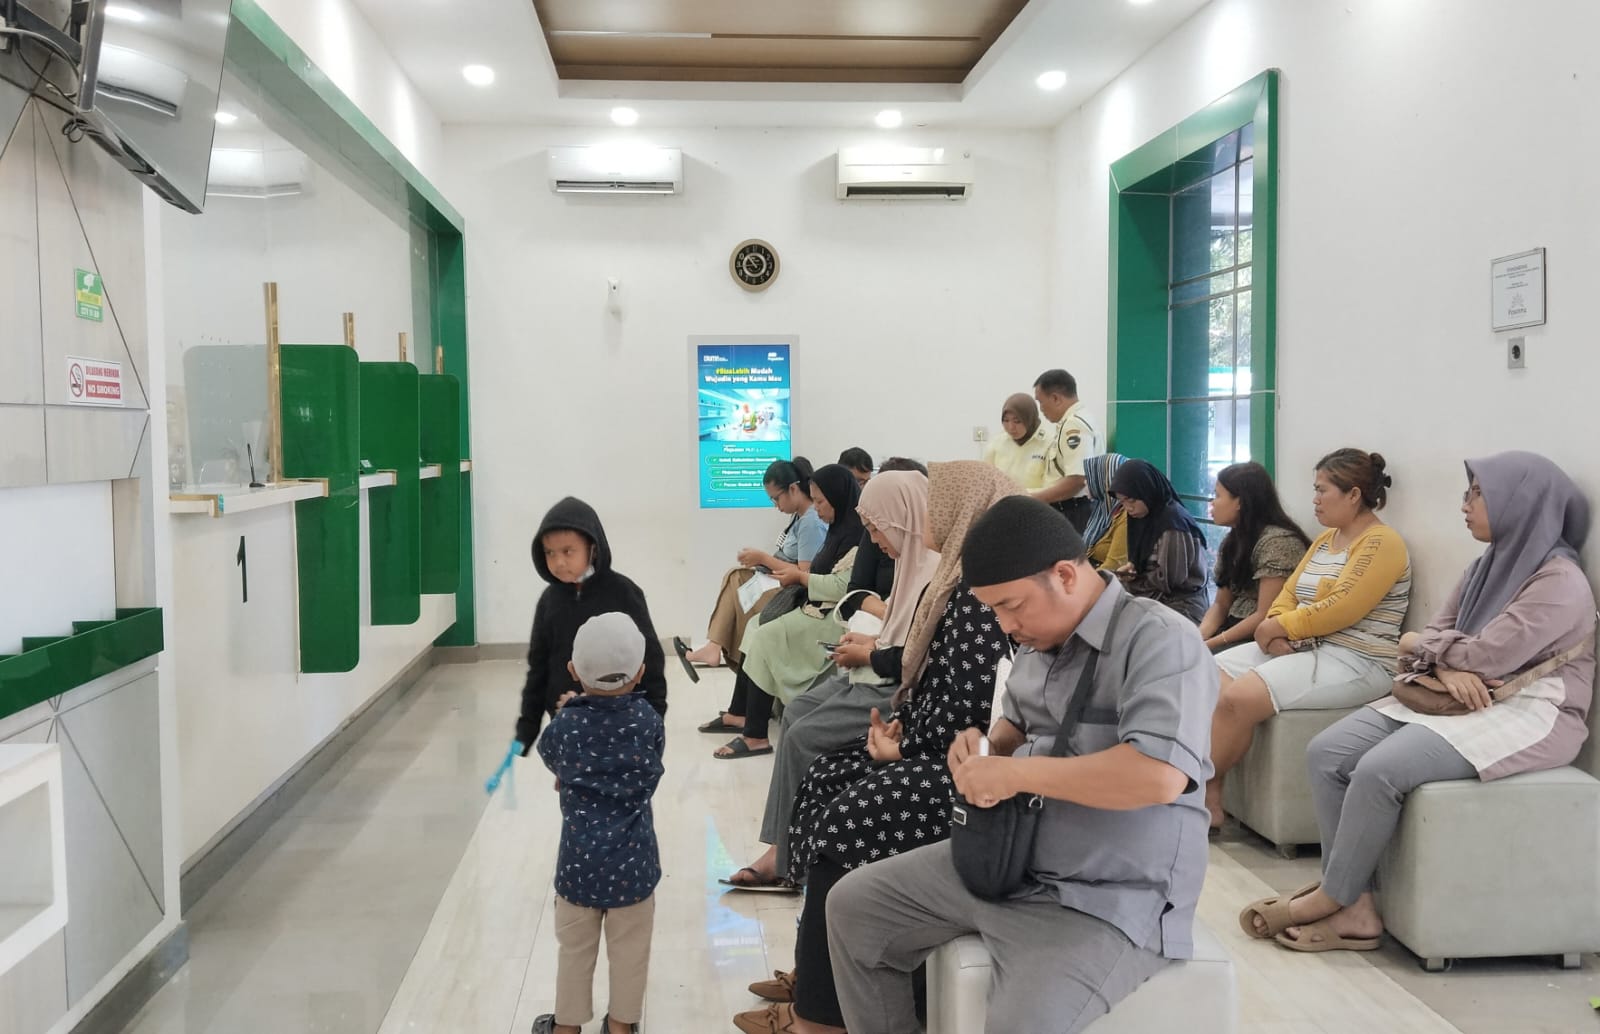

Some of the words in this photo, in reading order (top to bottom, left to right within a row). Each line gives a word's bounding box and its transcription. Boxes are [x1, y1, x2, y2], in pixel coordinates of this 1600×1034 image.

[750, 367, 773, 375] Mudah
[87, 383, 96, 394] NO
[96, 384, 120, 395] SMOKING
[1350, 553, 1376, 577] YOUR
